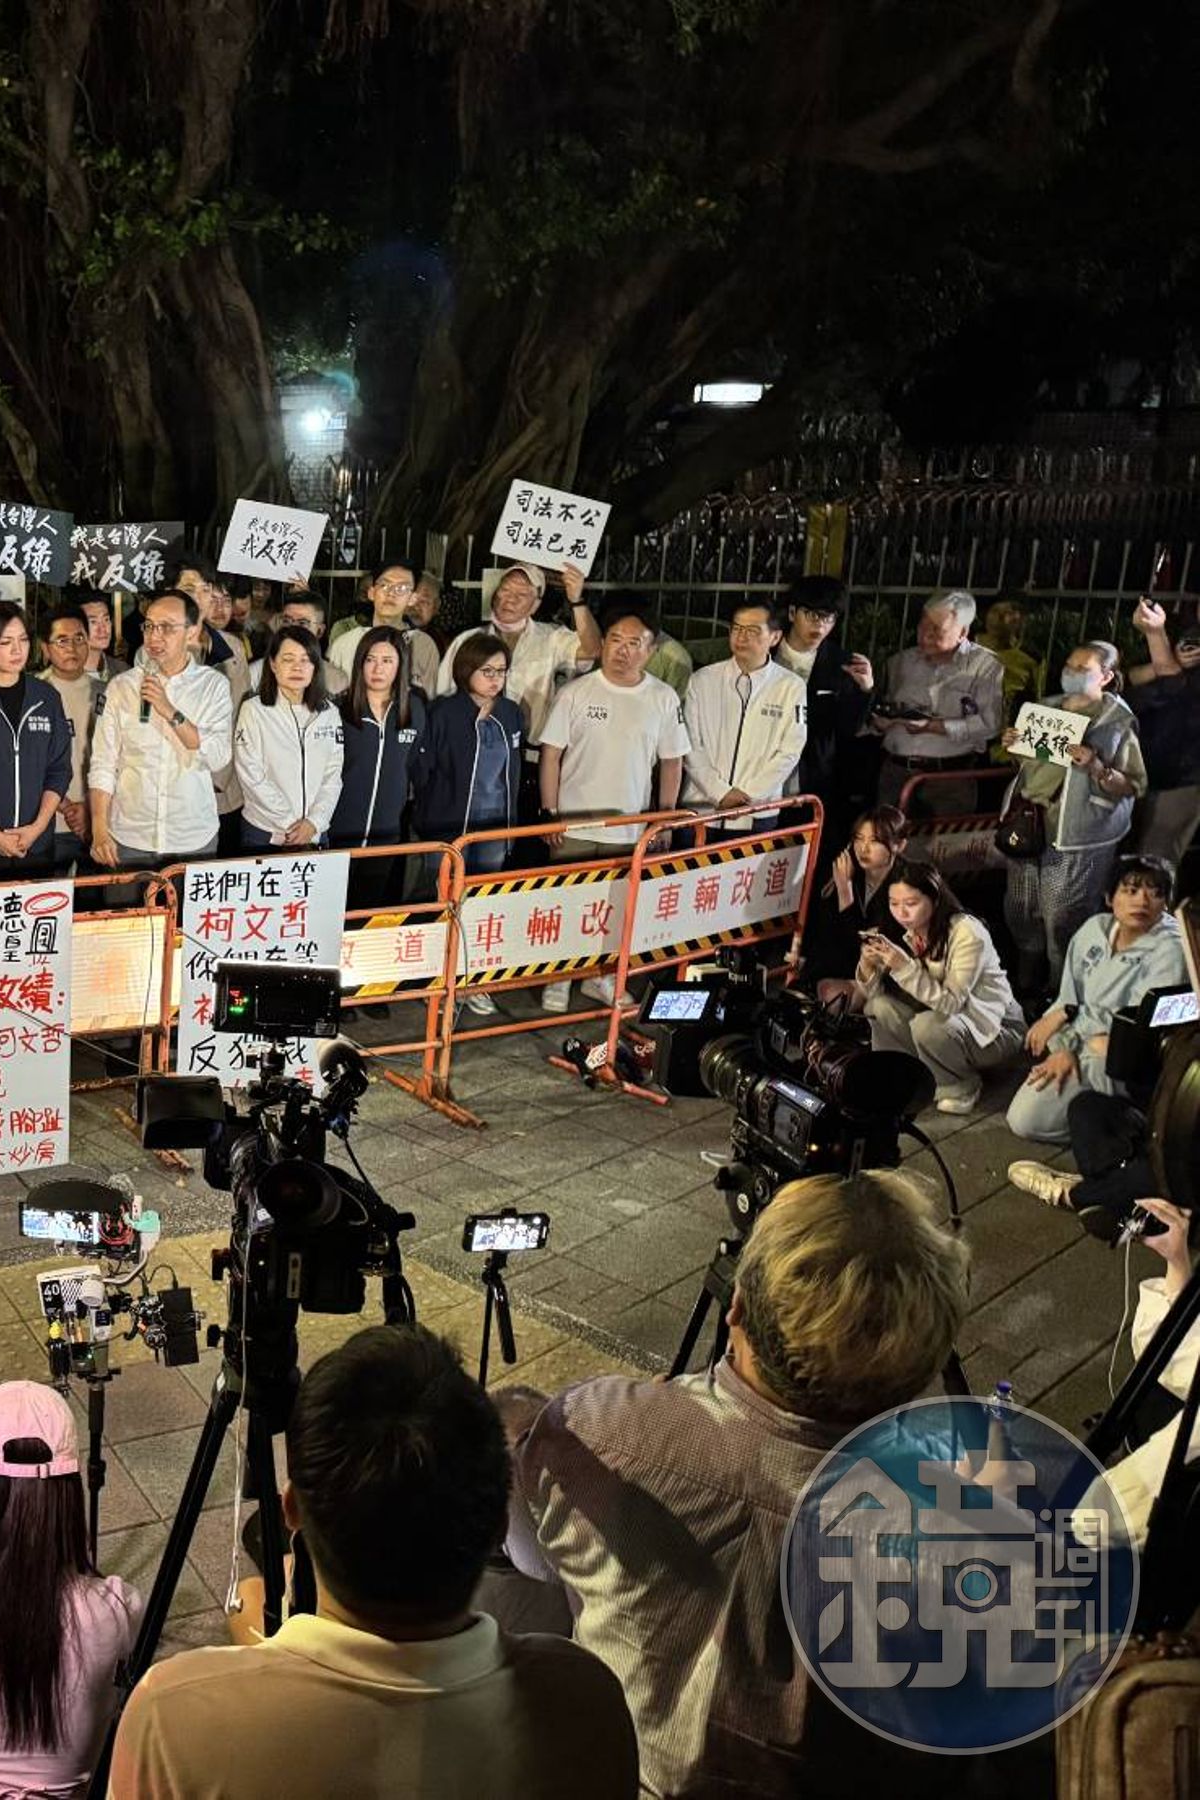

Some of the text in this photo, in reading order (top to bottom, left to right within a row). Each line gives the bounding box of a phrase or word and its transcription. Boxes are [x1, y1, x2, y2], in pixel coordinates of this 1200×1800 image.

[516, 489, 601, 528] 司法不公
[69, 523, 168, 551] 我是台灣人
[240, 532, 298, 566] 我反綠
[505, 520, 588, 559] 司法已死
[69, 549, 166, 594] 我反綠
[188, 861, 318, 902] 我們在等
[654, 857, 790, 922] 車輛改道
[196, 900, 309, 943] 柯文哲
[470, 902, 615, 952] 車輛改
